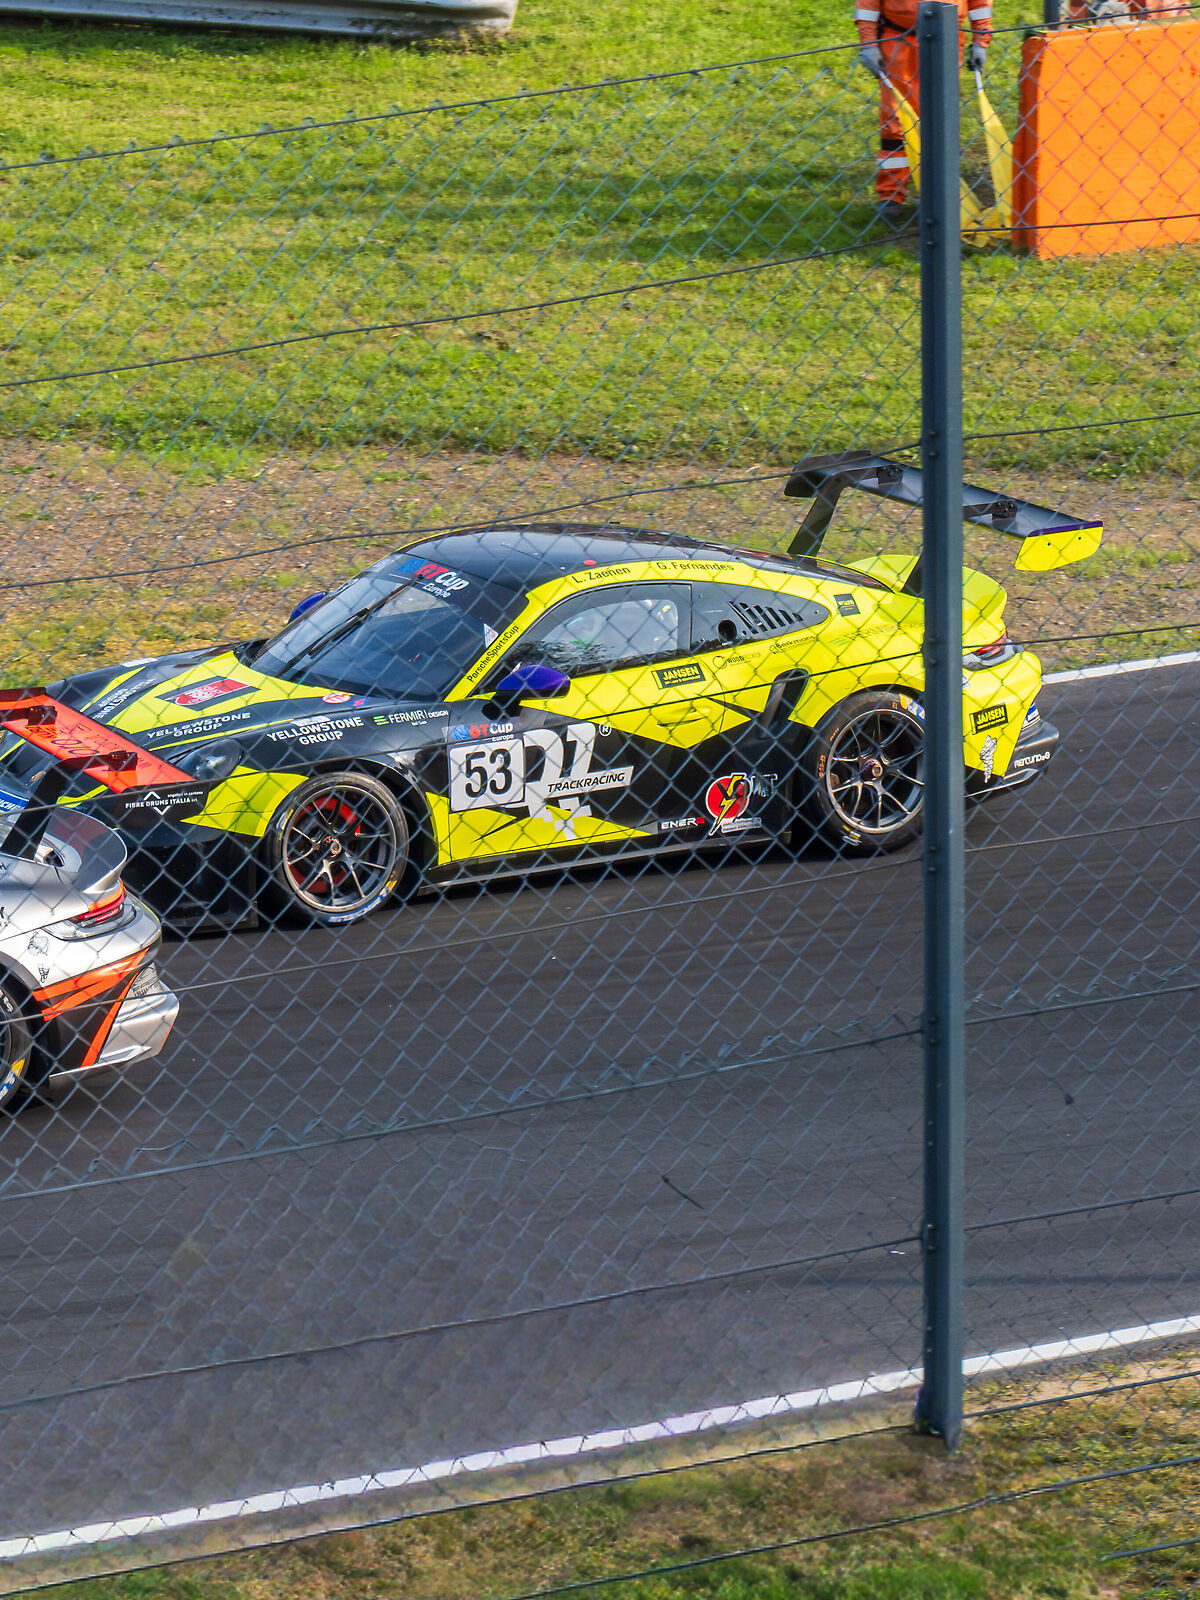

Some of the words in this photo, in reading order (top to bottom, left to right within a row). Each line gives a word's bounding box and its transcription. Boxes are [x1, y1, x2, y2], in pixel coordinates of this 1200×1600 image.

[672, 561, 735, 572] Fernandes
[414, 564, 450, 580] GT
[434, 571, 470, 591] Cup
[571, 575, 586, 584] L.
[422, 582, 452, 598] Europe
[662, 665, 700, 681] JANSEN
[428, 710, 449, 719] DESIGN
[976, 706, 1006, 725] JANSEN
[147, 712, 251, 739] YELLOWSTONE
[173, 723, 223, 738] GROUP
[267, 716, 364, 743] YELLOWSTONE
[469, 724, 490, 738] GT
[489, 722, 514, 734] Cup
[299, 730, 343, 746] GROUP
[491, 733, 514, 742] Europe
[465, 748, 513, 798] 53
[547, 772, 626, 793] TRACKRACING
[125, 801, 145, 809] FIBRE
[145, 799, 169, 807] DRUMS
[169, 797, 191, 805] ITALIA
[661, 816, 705, 830] ENERG
